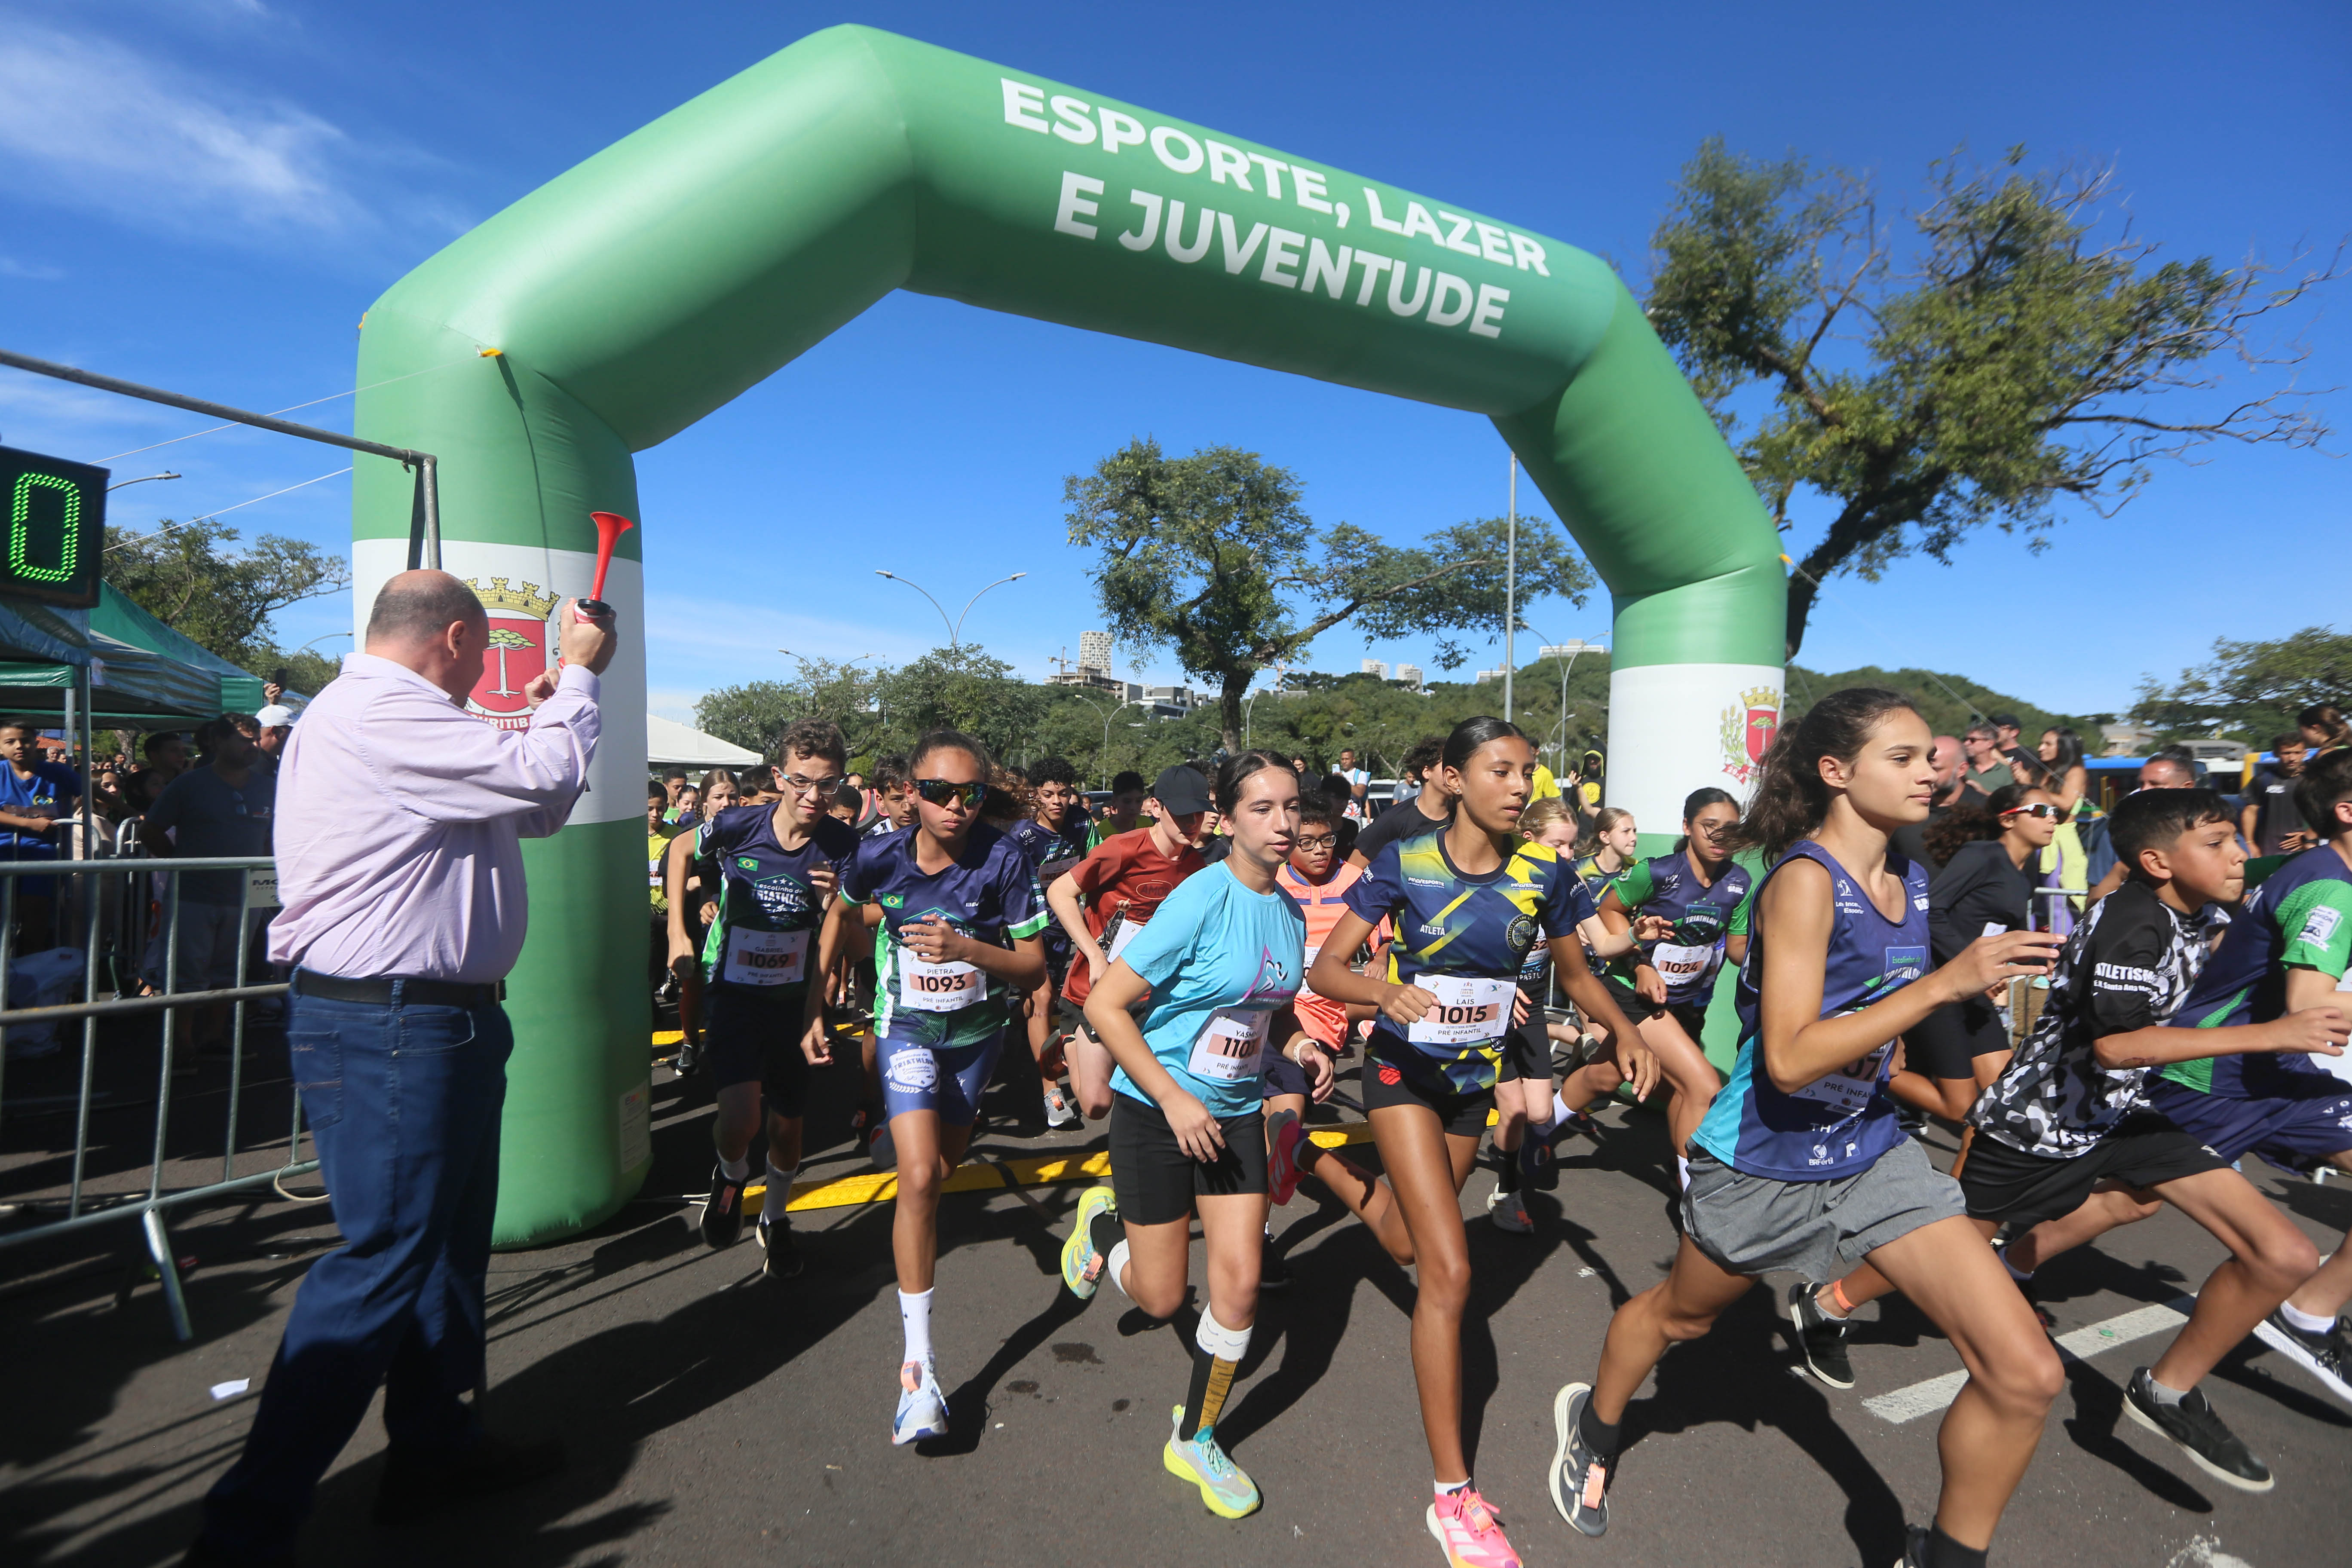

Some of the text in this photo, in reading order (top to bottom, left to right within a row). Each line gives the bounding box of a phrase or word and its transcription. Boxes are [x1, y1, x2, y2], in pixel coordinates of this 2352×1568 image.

[1001, 77, 1551, 277] ESPORTE, LAZER
[1054, 170, 1510, 339] E JUVENTUDE
[1363, 865, 1374, 882] OPEL
[1685, 915, 1718, 926] TRIATHLON
[1420, 923, 1446, 936] ATLETA
[747, 951, 789, 968] 1069
[1664, 961, 1698, 974] 1024
[917, 974, 966, 992] 1093
[2104, 981, 2122, 991] Santa
[2123, 983, 2138, 992] Ana
[936, 995, 964, 1004] INFANTIL
[1438, 1005, 1488, 1024] 1015
[893, 1057, 934, 1070] TRIATHLON
[1823, 1081, 1844, 1092] PRÉ
[1808, 1157, 1834, 1166] BRFértil
